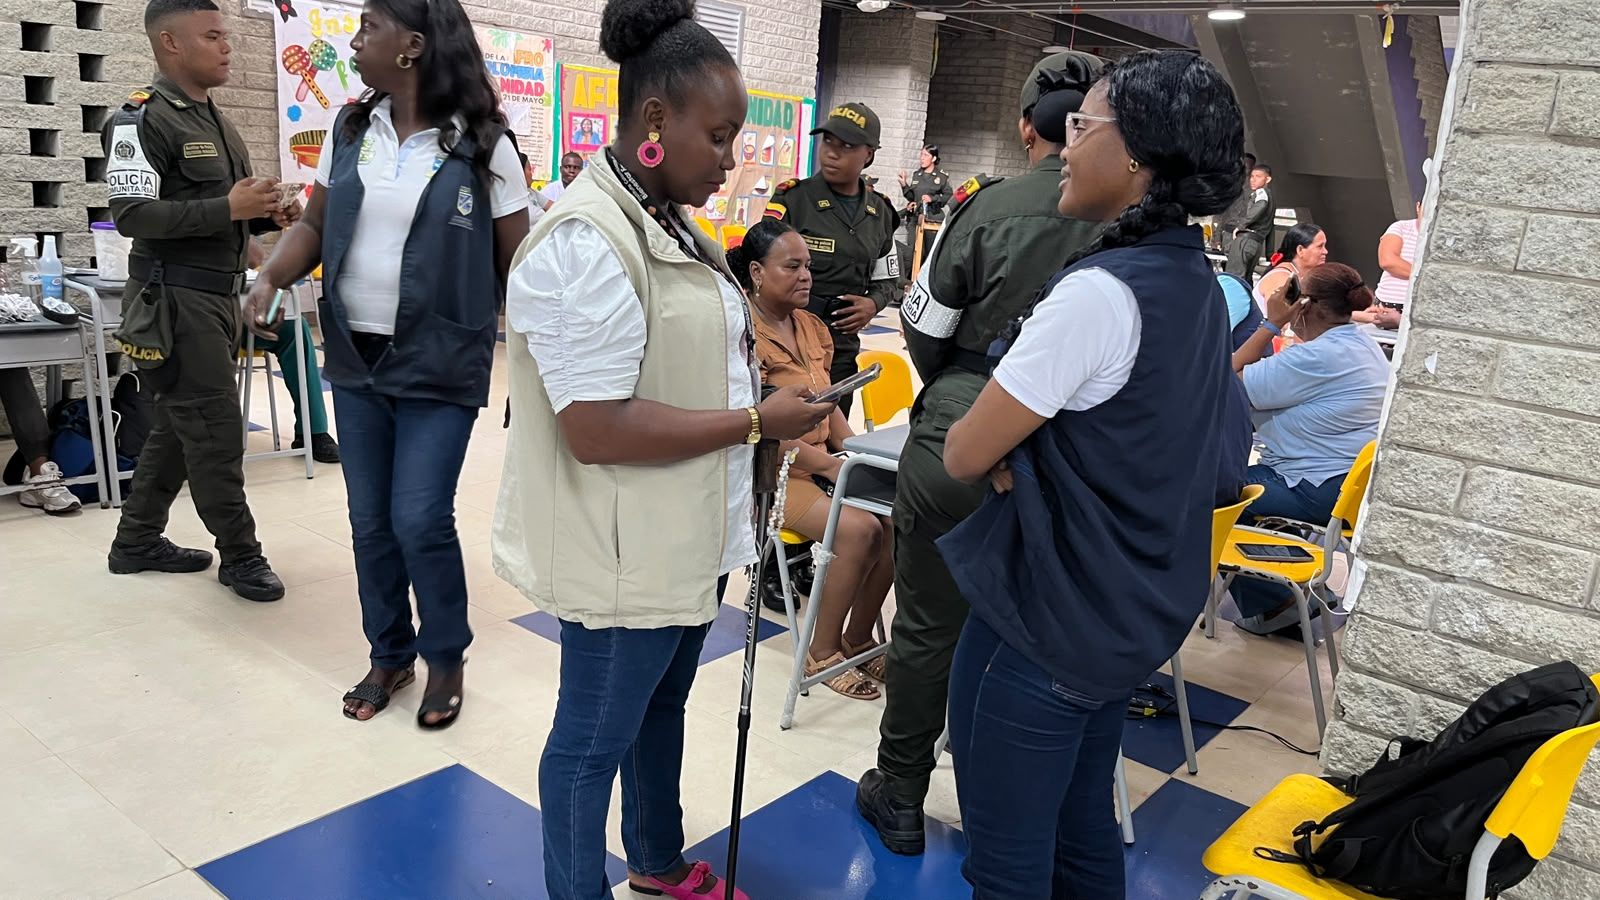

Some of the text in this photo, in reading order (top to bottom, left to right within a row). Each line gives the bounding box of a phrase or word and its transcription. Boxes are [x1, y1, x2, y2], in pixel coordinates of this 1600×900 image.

[500, 77, 545, 97] NIDAD
[522, 96, 544, 104] MAYO
[746, 95, 794, 131] NIDAD
[109, 172, 153, 188] OLICÍA
